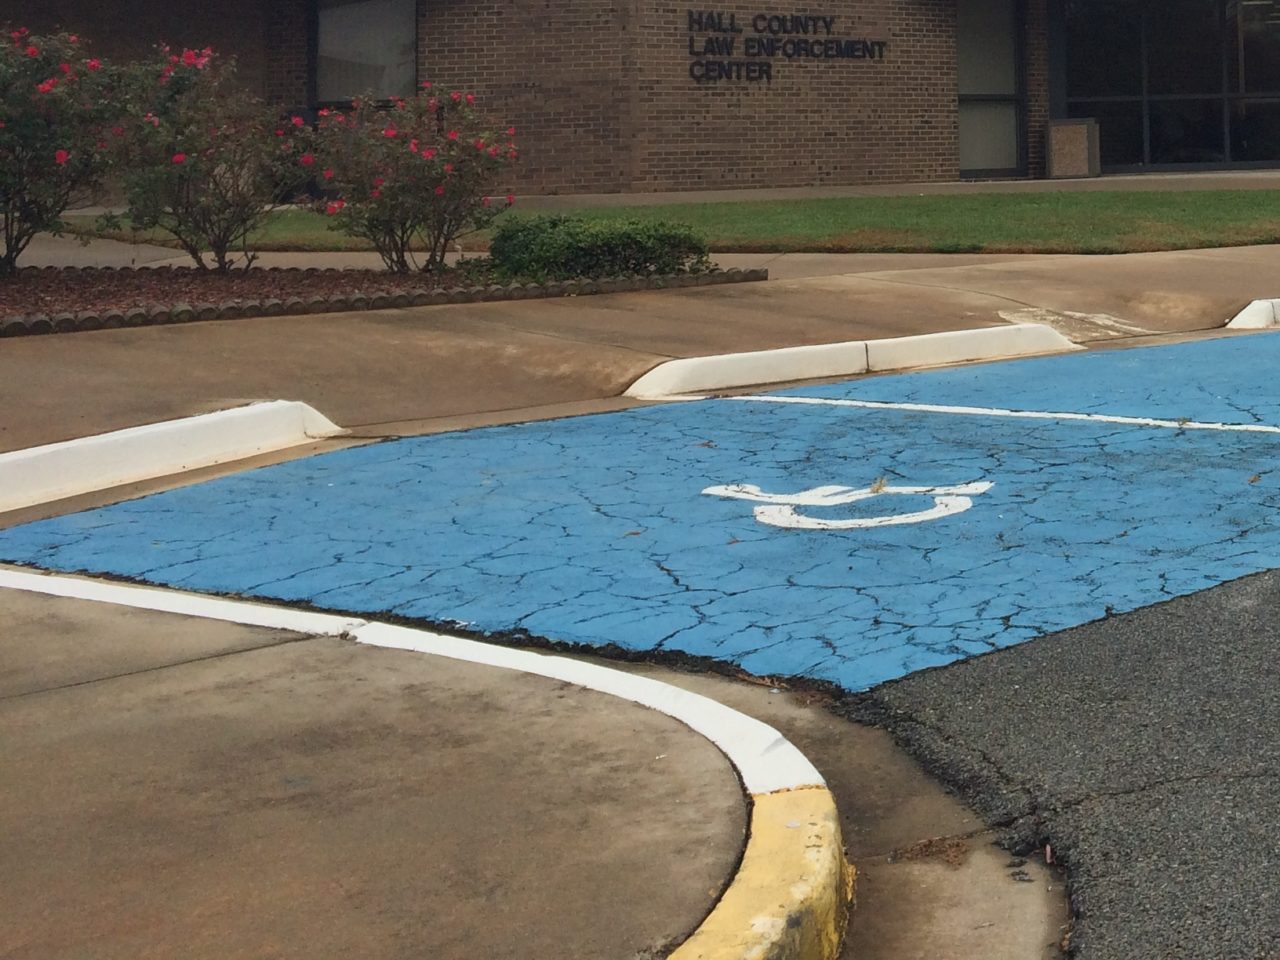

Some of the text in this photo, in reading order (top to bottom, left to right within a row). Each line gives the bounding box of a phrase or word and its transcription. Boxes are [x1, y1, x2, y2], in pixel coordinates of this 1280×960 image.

[688, 9, 834, 35] HALL COUNTY
[688, 36, 887, 60] LAW ENFORCEMENT
[689, 60, 772, 84] CENTER
